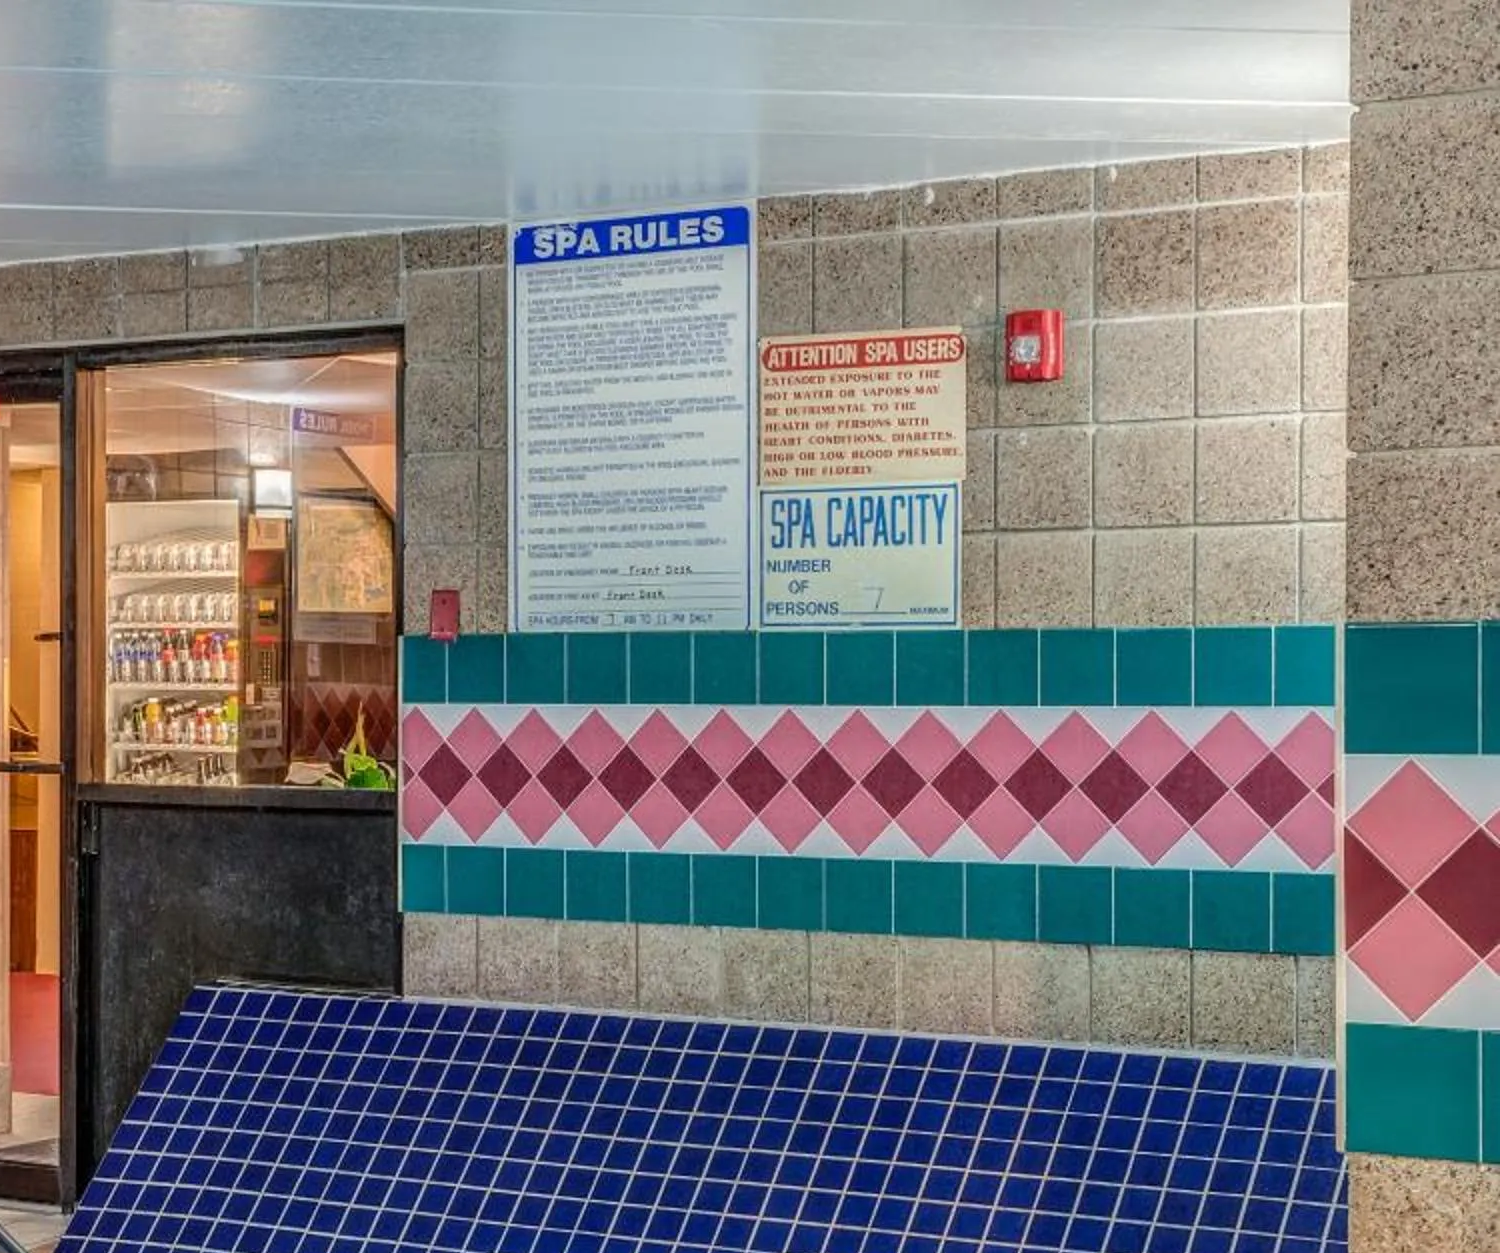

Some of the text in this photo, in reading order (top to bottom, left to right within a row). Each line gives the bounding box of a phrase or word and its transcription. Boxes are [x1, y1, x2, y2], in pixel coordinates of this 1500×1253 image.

[533, 215, 725, 259] SPA RULES
[768, 337, 961, 369] ATTENTION SPA USERS
[763, 369, 942, 387] EXTENDED EXPOSURE TO THE
[763, 384, 941, 401] HOT WATER OR VAPORS MAY
[764, 401, 917, 417] BE DETRIMENTAL TO THE
[765, 417, 930, 433] HEALTH OF PERSONS WITH
[764, 437, 802, 447] HEART
[764, 452, 794, 463] HIGH
[799, 451, 815, 461] OR
[820, 450, 846, 461] LOW
[851, 449, 893, 460] BLOOD
[764, 466, 788, 478] AND
[793, 466, 817, 477] THE
[771, 497, 816, 549] SPA
[827, 493, 949, 548] CAPACITY
[766, 559, 831, 573] NUMBER
[788, 579, 810, 595] OF
[766, 601, 840, 616] PERSONS
